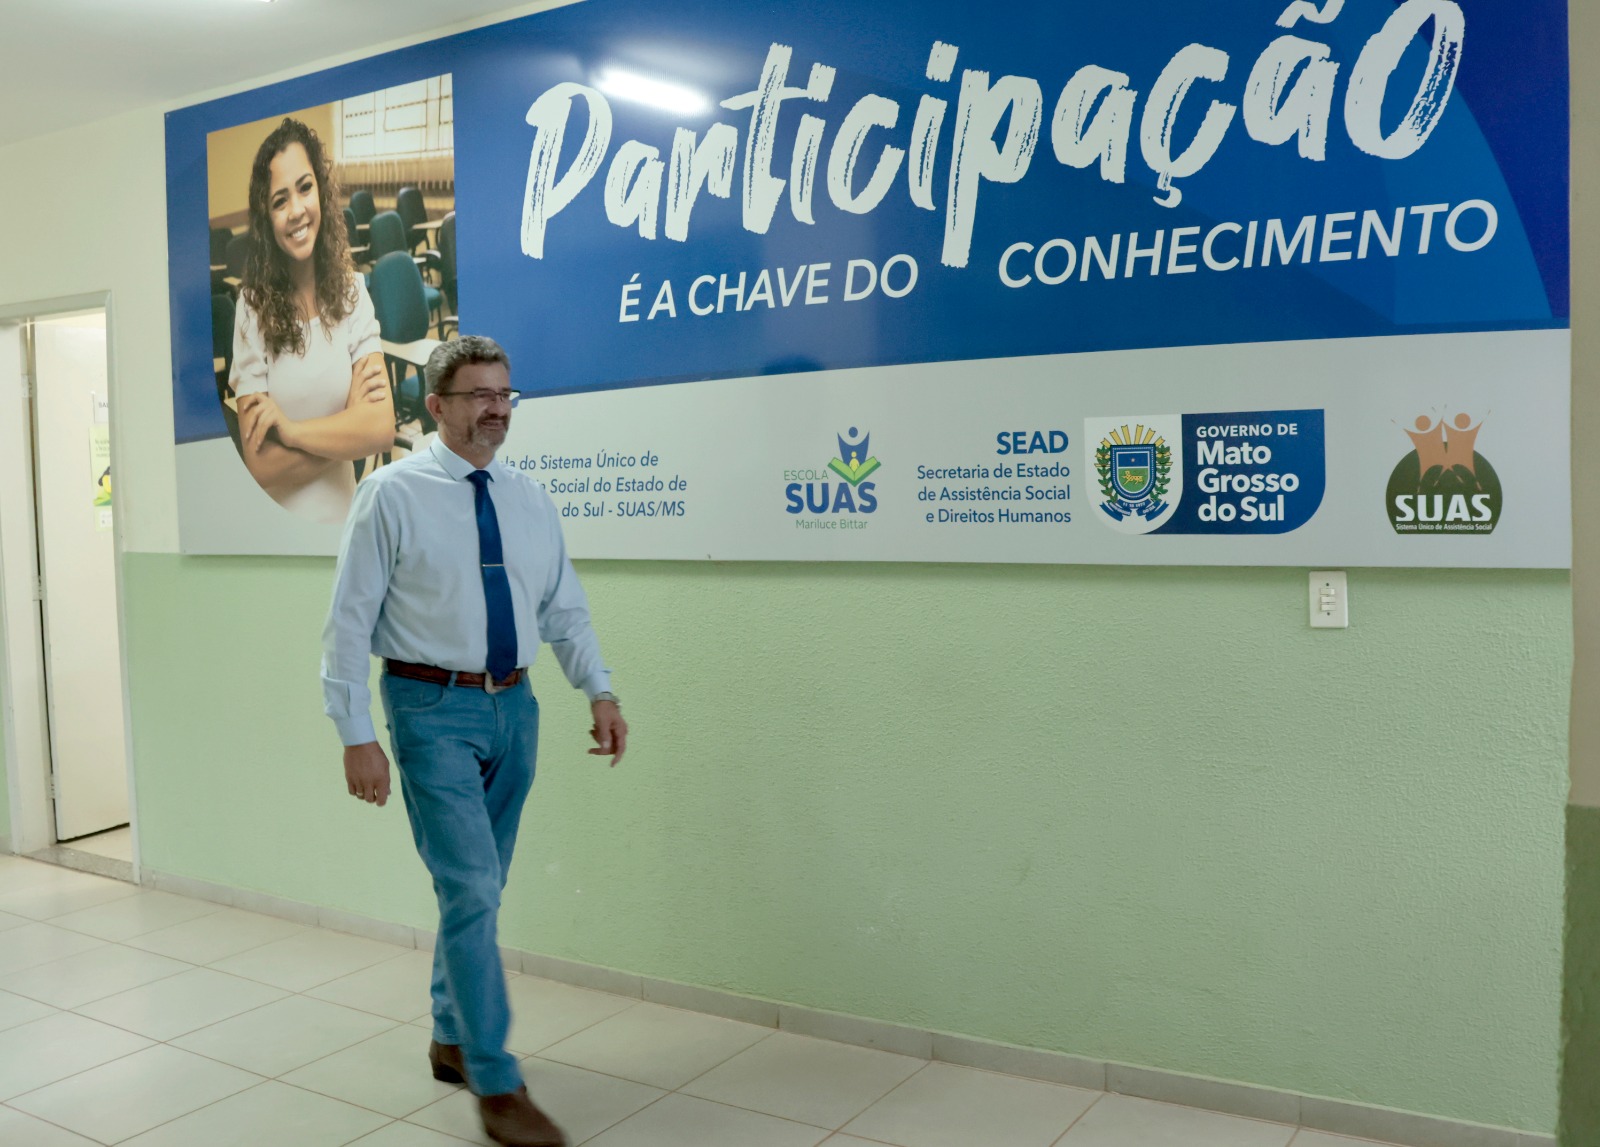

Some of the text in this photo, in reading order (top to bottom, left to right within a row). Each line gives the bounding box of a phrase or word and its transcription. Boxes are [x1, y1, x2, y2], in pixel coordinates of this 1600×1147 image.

[520, 0, 1465, 268] Participação
[619, 199, 1499, 322] É A CHAVE DO CONHECIMENTO
[1196, 423, 1298, 438] GOVERNO DE
[996, 430, 1069, 455] SEAD
[519, 455, 537, 470] do
[540, 454, 592, 470] Sistema
[596, 449, 636, 468] Único
[640, 450, 659, 467] de
[1197, 440, 1272, 466] Mato
[783, 469, 829, 481] ESCOLA
[917, 462, 1070, 479] Secretaria de Estado
[1197, 467, 1300, 494] Grosso
[550, 476, 590, 493] Social
[593, 477, 612, 493] do
[616, 475, 664, 493] Estado
[668, 474, 687, 491] de
[918, 484, 1071, 501] de Assistência Social
[785, 481, 878, 514] SUAS
[1395, 493, 1492, 522] SUAS
[561, 502, 579, 518] do
[583, 501, 604, 518] Sul
[616, 500, 686, 518] SUAS/MS
[925, 508, 1072, 523] e Direitos Humanos
[1197, 494, 1285, 522] do Sul
[795, 518, 869, 530] Mariluce Bittar
[1396, 523, 1418, 531] Sistema
[1435, 523, 1442, 531] de
[1443, 523, 1475, 531] Assistência
[1475, 523, 1493, 531] Social
